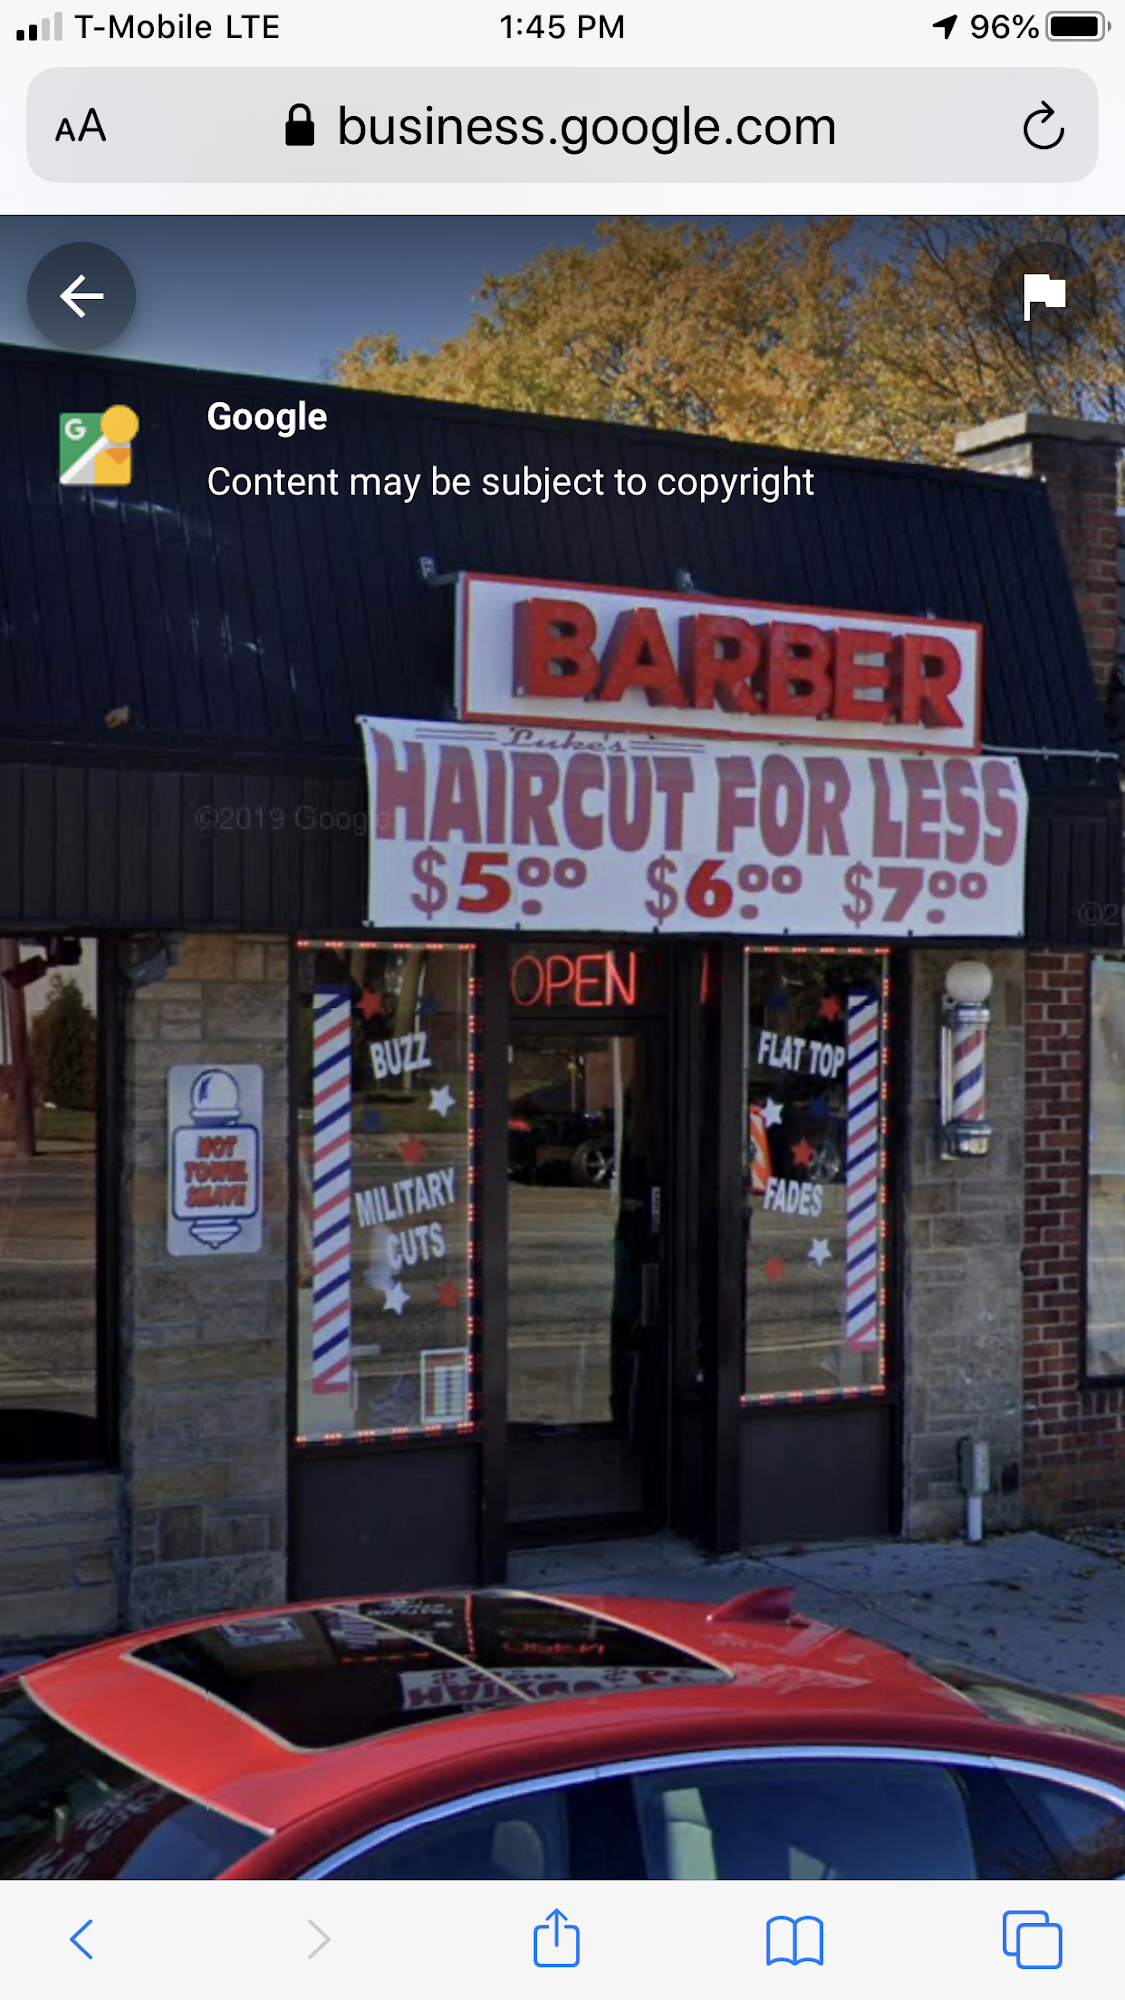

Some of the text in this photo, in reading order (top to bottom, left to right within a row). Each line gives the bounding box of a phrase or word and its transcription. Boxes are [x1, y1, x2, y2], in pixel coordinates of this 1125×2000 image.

[74, 13, 279, 39] T-Mobile LTE
[500, 14, 626, 40] 1:45 PM
[970, 14, 1040, 40] 96%
[339, 105, 836, 155] business.google.com
[64, 418, 87, 441] G
[512, 597, 964, 729] BARBER
[500, 726, 628, 753] Luke's
[369, 727, 1019, 867] HAIRCUT FOR LESS
[410, 845, 988, 928] $5.00 $6.00 $7.00
[510, 950, 636, 1008] OPEN
[368, 1031, 432, 1080] BUZZ
[757, 1030, 846, 1080] FLAT TOP
[353, 1167, 456, 1229] MILITARY
[762, 1175, 824, 1218] FADES
[386, 1221, 445, 1272] CUTS
